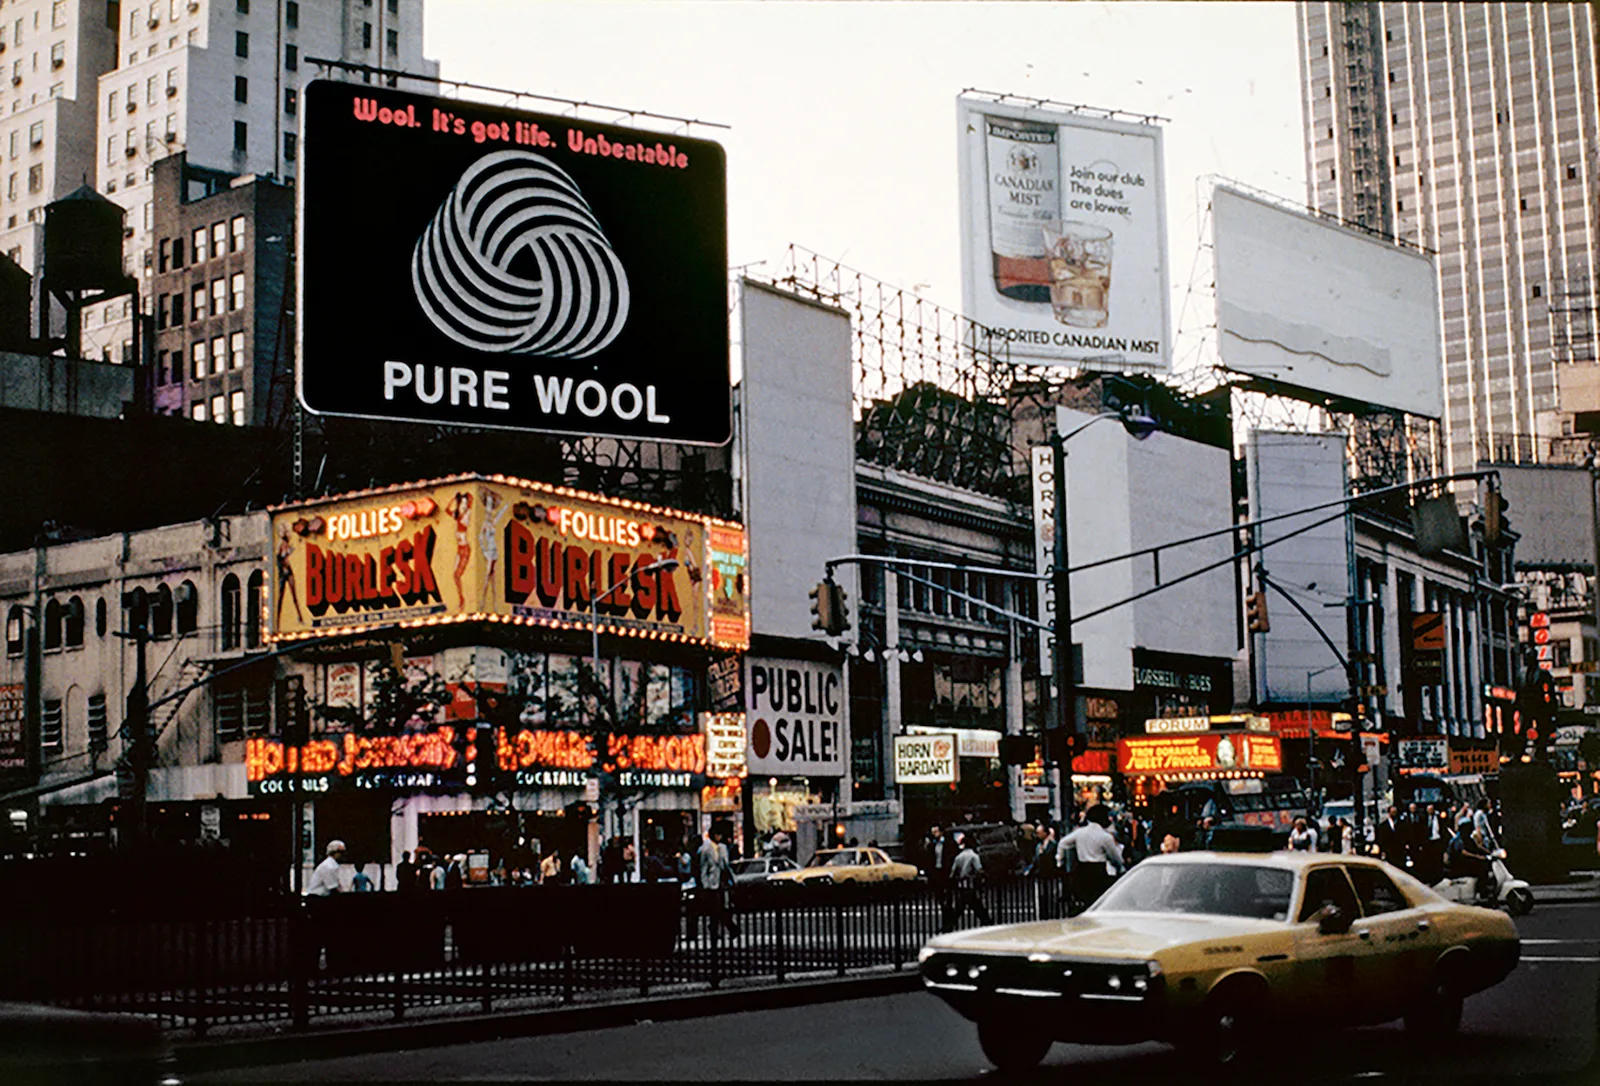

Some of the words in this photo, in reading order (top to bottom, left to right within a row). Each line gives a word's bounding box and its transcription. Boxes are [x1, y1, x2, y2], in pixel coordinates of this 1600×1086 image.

[353, 97, 421, 129] Wool.
[432, 108, 466, 135] It's
[470, 119, 510, 144] got
[515, 121, 557, 149] life.
[567, 129, 689, 169] Unbeatable
[994, 173, 1054, 191] CANADIAN
[1070, 165, 1095, 180] Join
[1098, 172, 1118, 183] our
[1120, 172, 1145, 187] club
[1070, 180, 1092, 195] The
[1094, 184, 1123, 199] dues
[1010, 191, 1041, 206] MIST
[1070, 199, 1092, 210] are
[1094, 199, 1132, 215] lower.
[981, 327, 1049, 345] IMPORTED
[1053, 332, 1127, 351] CANADIAN
[1129, 340, 1160, 354] MIST
[384, 360, 510, 410] PURE
[533, 374, 670, 424] WOOL
[1039, 454, 1054, 520] HORN
[326, 505, 404, 541] FOLLIES
[559, 507, 641, 547] FOLLIES
[305, 524, 441, 612] BURLESK
[505, 519, 681, 621] BURLESK
[751, 665, 839, 716] PUBLIC
[1150, 718, 1208, 732] FORUM
[775, 718, 839, 762] SALE!
[898, 743, 931, 758] HORN
[898, 760, 951, 776] HARDART
[259, 776, 329, 794] COCAILS
